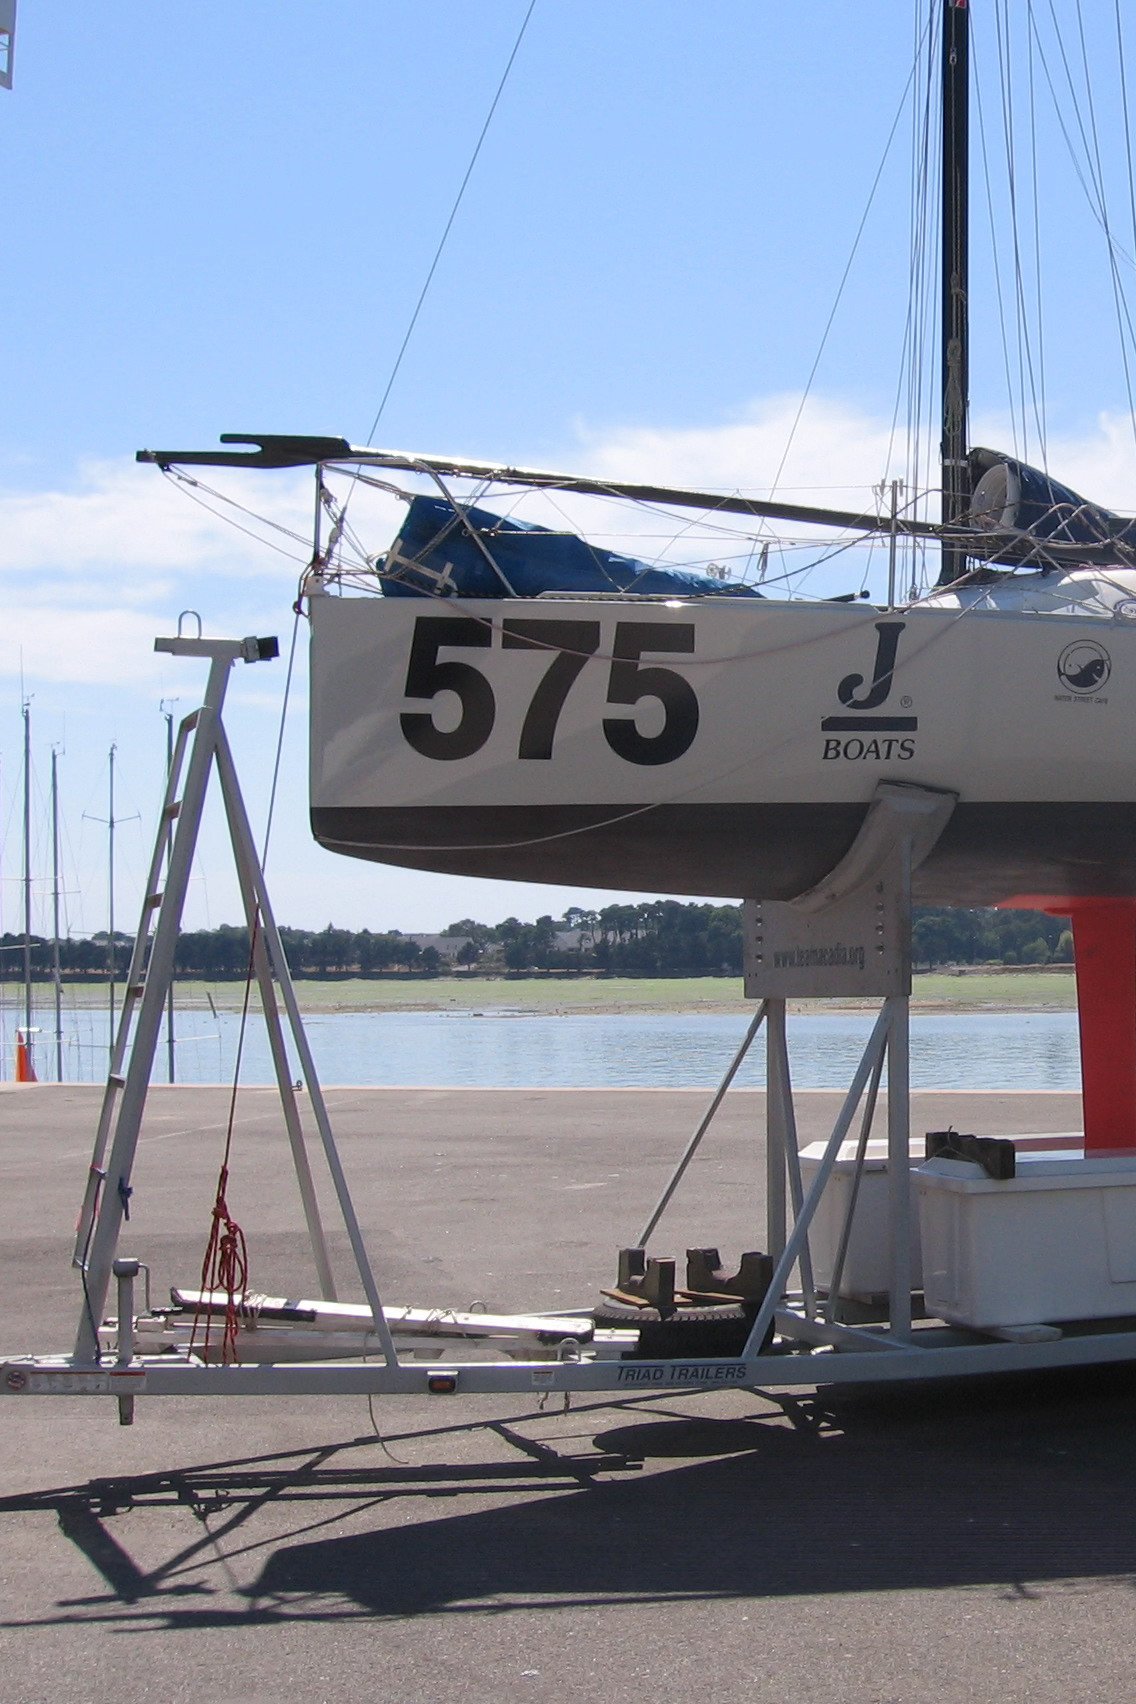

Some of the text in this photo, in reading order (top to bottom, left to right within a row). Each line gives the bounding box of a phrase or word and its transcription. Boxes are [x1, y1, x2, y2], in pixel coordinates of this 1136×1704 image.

[400, 616, 699, 766] 575
[838, 622, 906, 710] J
[822, 738, 916, 761] BOATS
[617, 1363, 748, 1381] TRIAD TRAILERS
